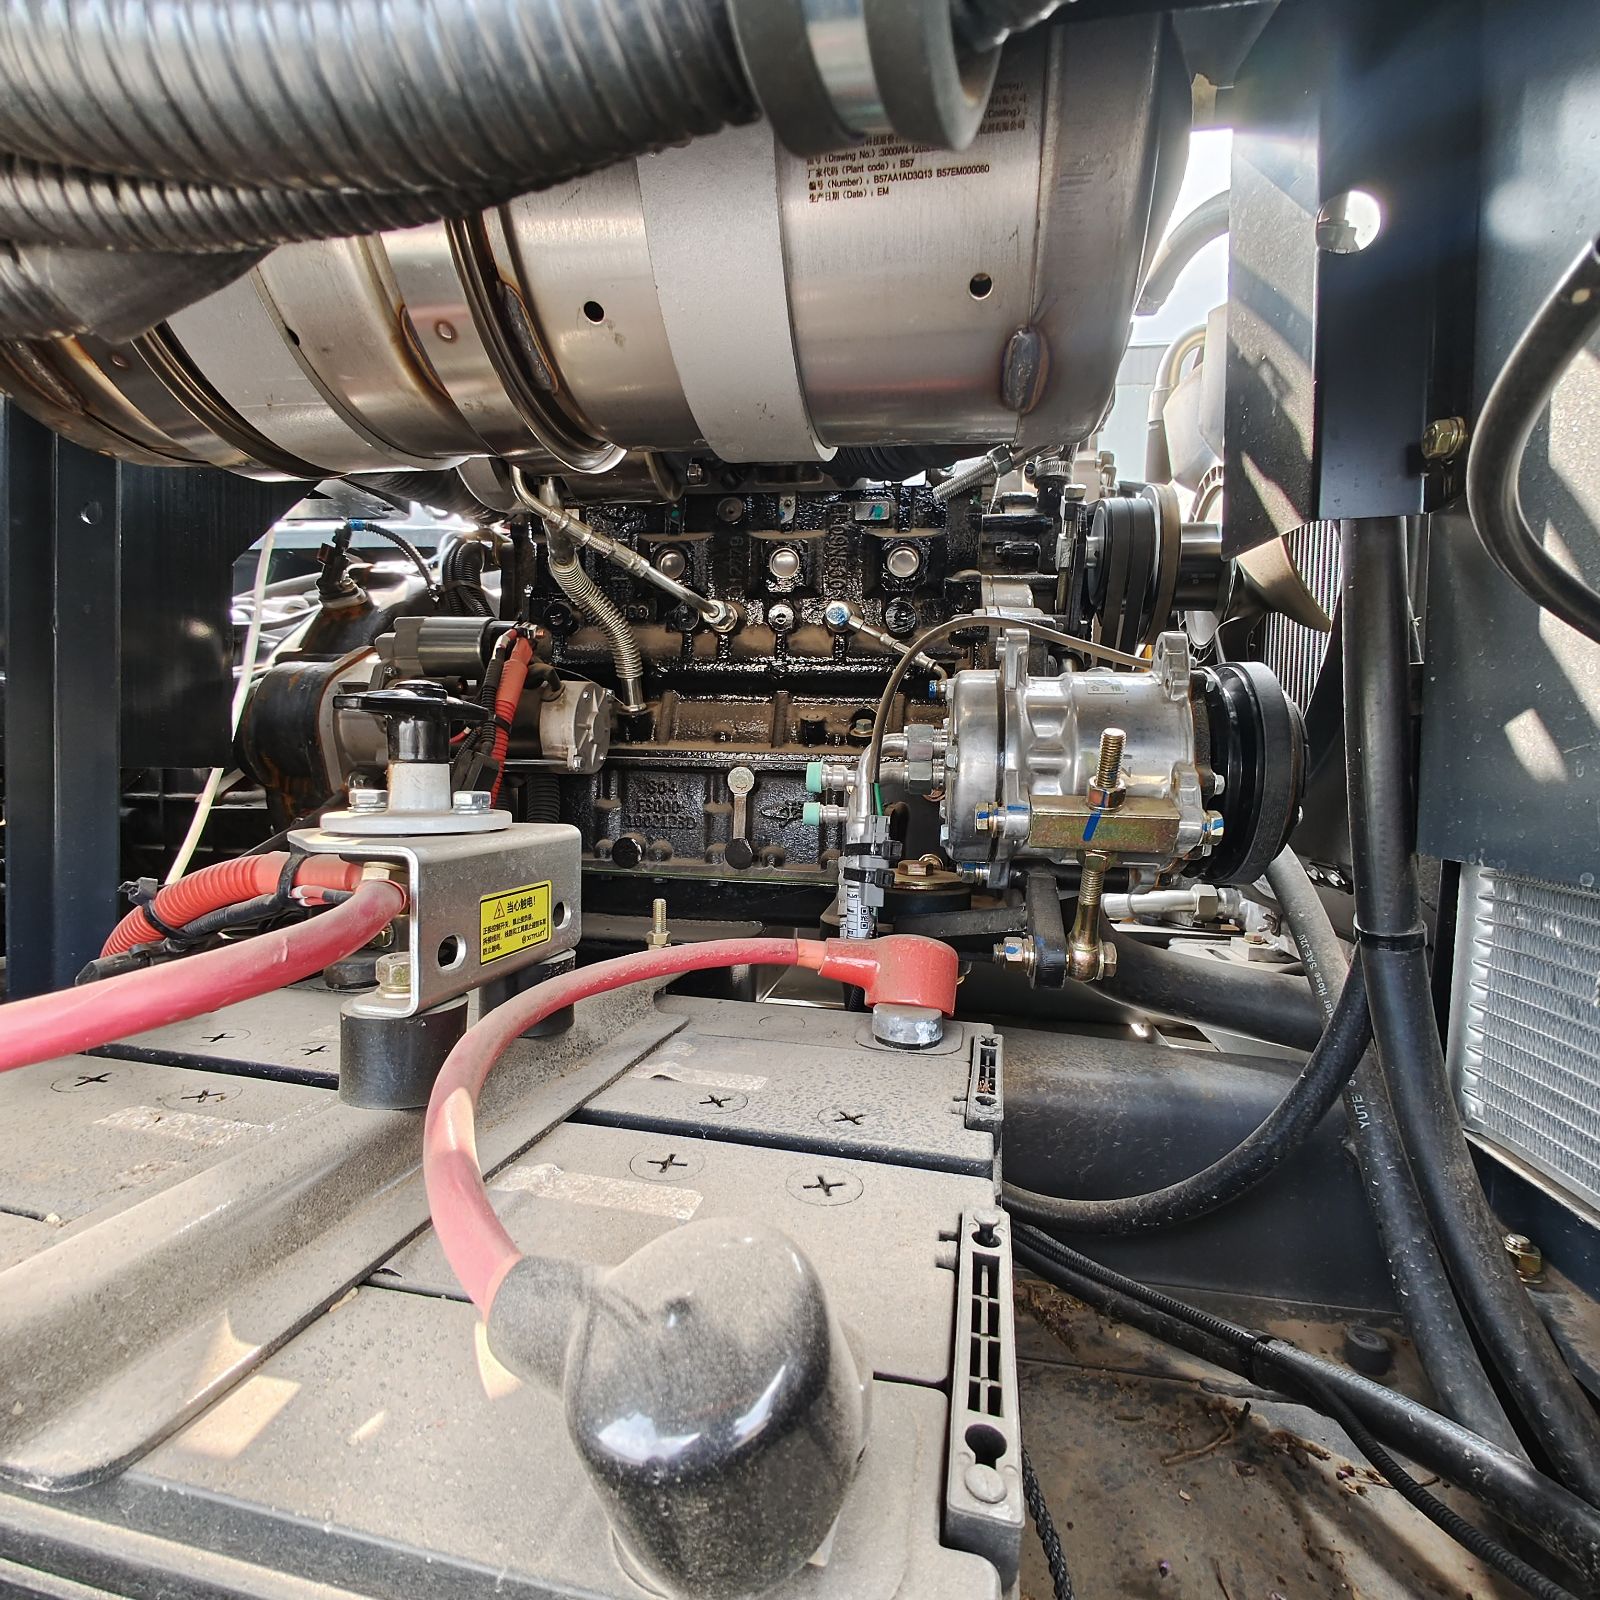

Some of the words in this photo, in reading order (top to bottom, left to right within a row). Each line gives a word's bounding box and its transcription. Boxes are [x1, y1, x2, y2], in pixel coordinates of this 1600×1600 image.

[900, 158, 914, 168] B57
[877, 186, 889, 196] EM
[1303, 949, 1318, 971] SAE
[1314, 970, 1329, 997] Hose
[1323, 997, 1335, 1019] ater
[1351, 1094, 1371, 1130] YUTE
